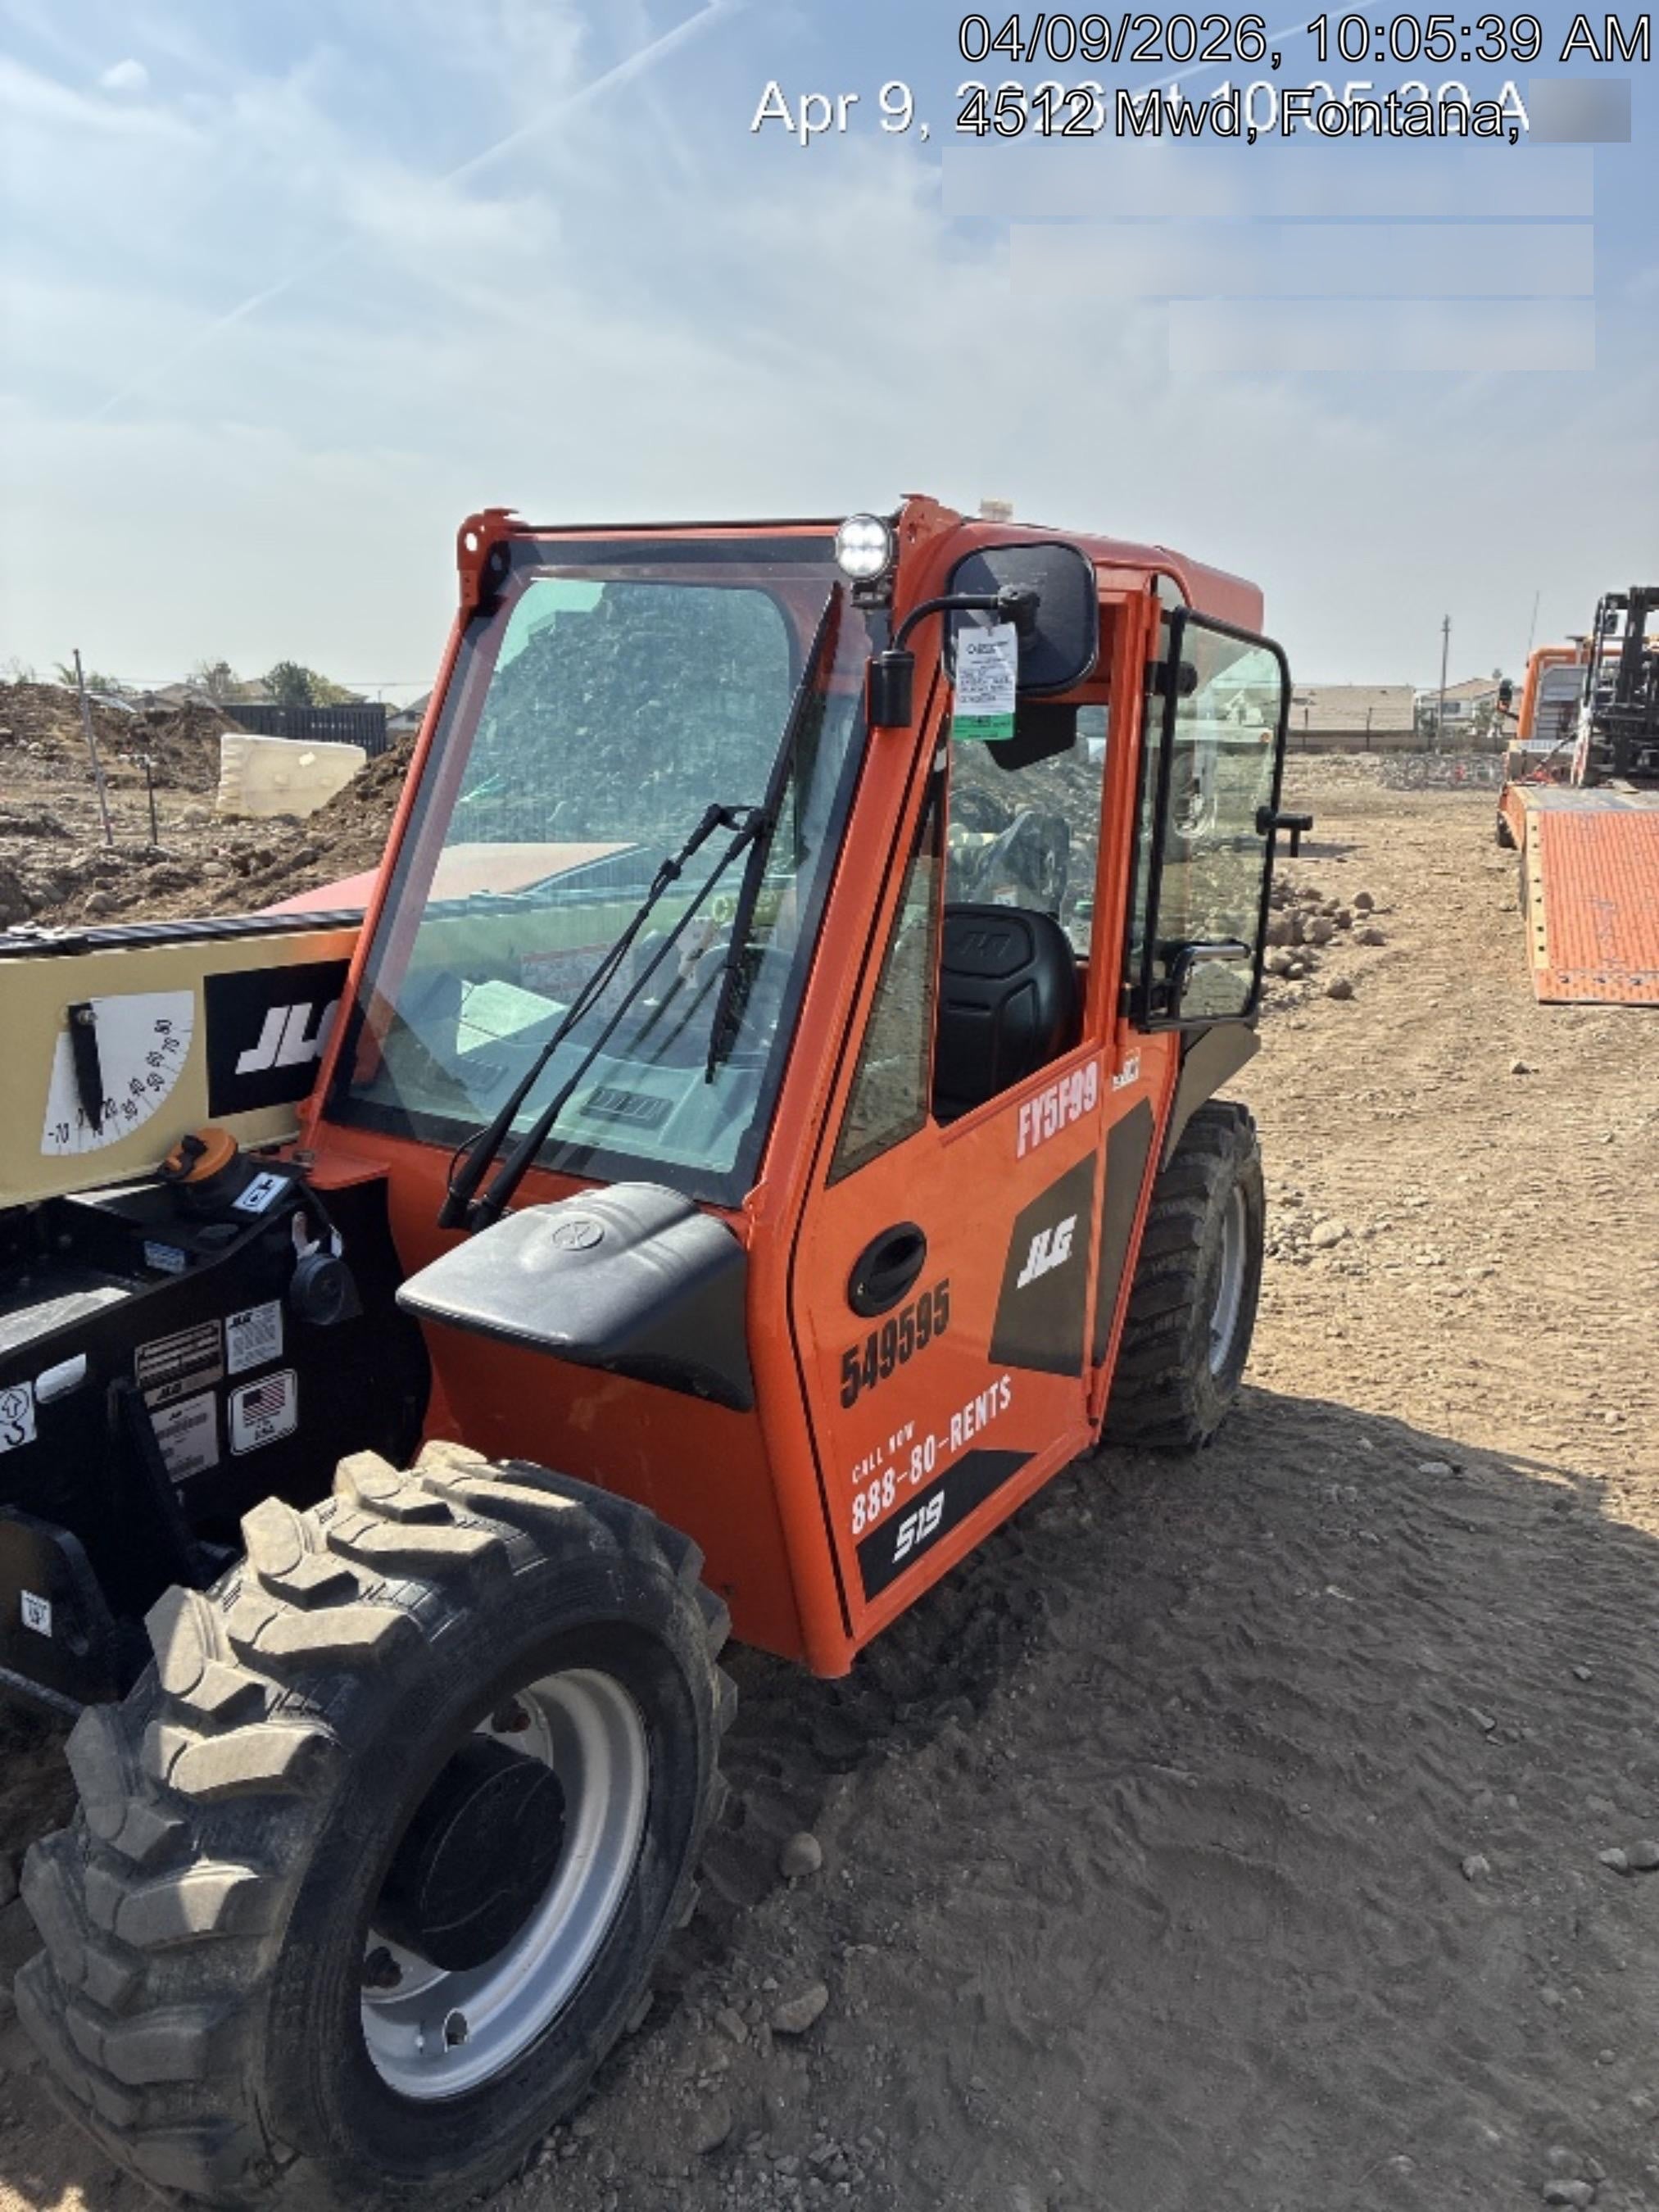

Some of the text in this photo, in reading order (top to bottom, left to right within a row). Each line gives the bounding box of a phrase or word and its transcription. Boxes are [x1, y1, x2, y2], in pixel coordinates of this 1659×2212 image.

[48, 1122, 70, 1144] -10
[1016, 1061, 1099, 1159] FY5F99
[1016, 1213, 1078, 1290] JLG
[840, 1277, 950, 1409] 549595
[851, 1372, 1013, 1535] 888-80-RENTS
[852, 1420, 915, 1485] CALL NOW
[892, 1488, 945, 1564] 519
